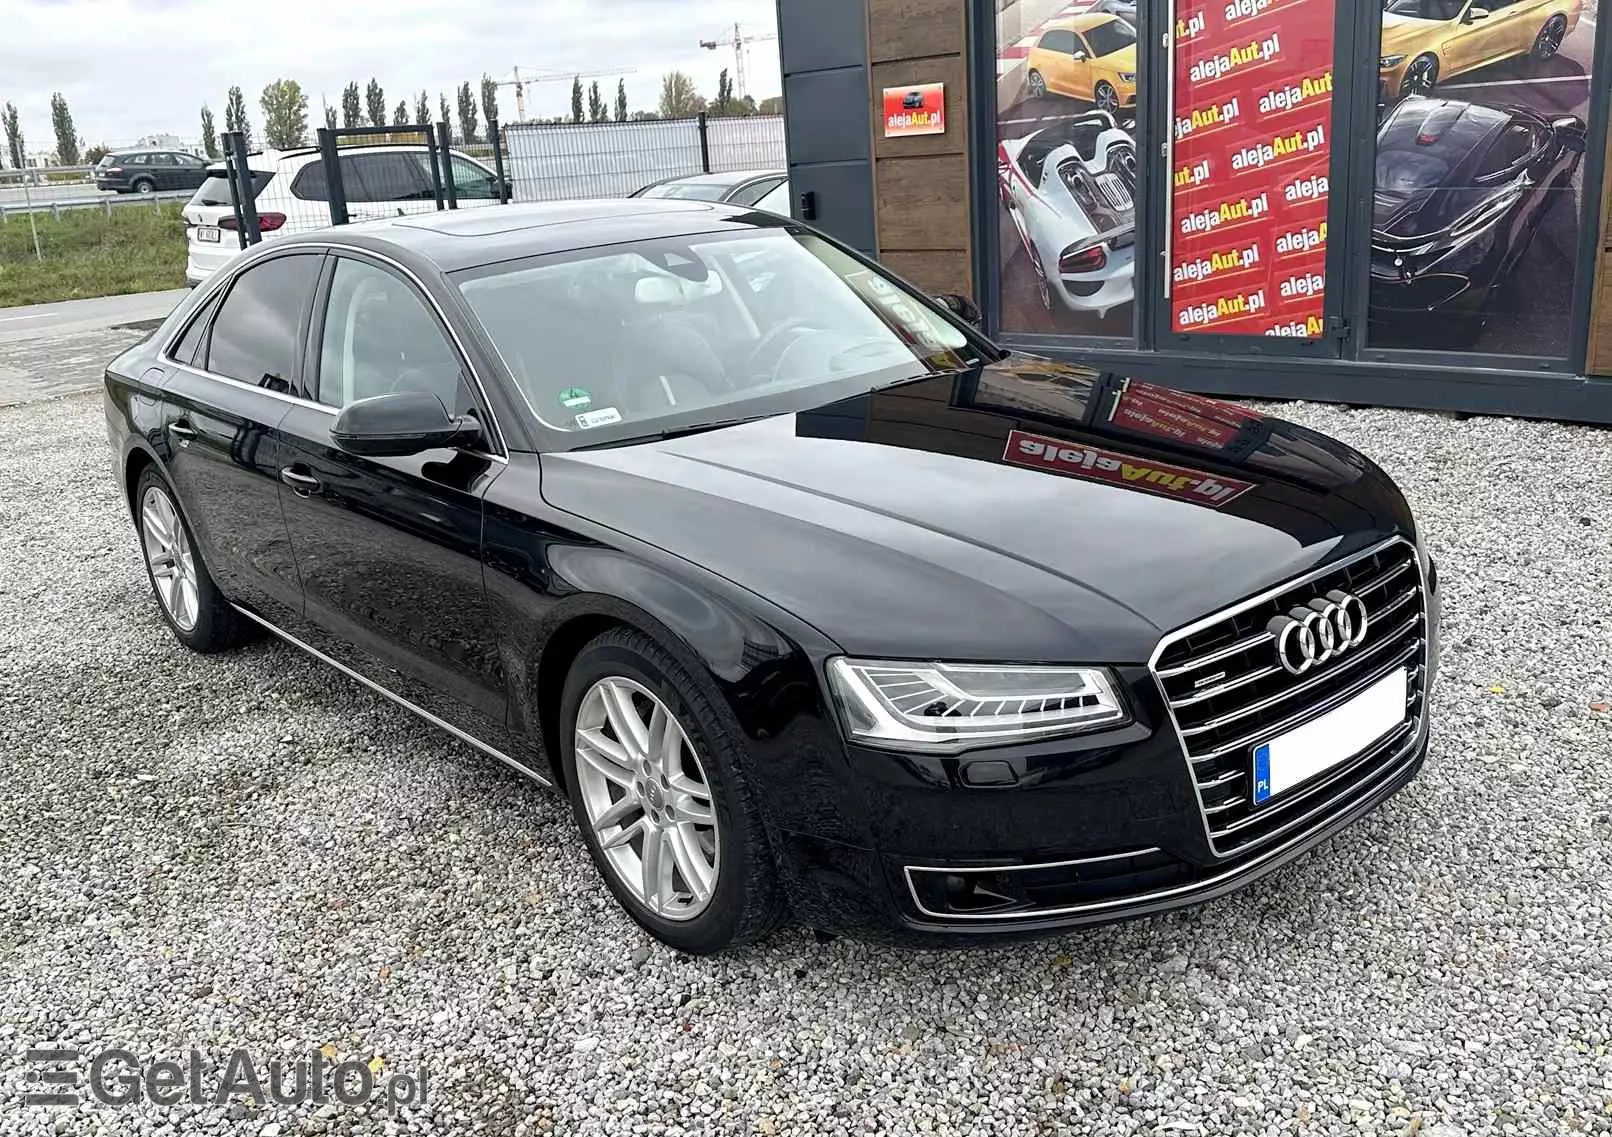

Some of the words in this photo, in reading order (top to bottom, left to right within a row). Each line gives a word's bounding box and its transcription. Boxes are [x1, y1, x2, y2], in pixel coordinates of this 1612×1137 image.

[1225, 0, 1272, 20] aleja
[1190, 33, 1280, 82] alejaAut.pl
[1259, 72, 1332, 113] alejaAut
[888, 110, 941, 128] alejaAut.pl
[1231, 125, 1325, 170] alejaAut.pl
[1285, 175, 1329, 201] aleja
[1181, 193, 1268, 234] alejaAut.pl
[1173, 244, 1259, 282] alejaAut.pl
[1280, 272, 1324, 297] aleja
[1179, 290, 1265, 325] alejaAut.pl
[1257, 779, 1269, 793] PL
